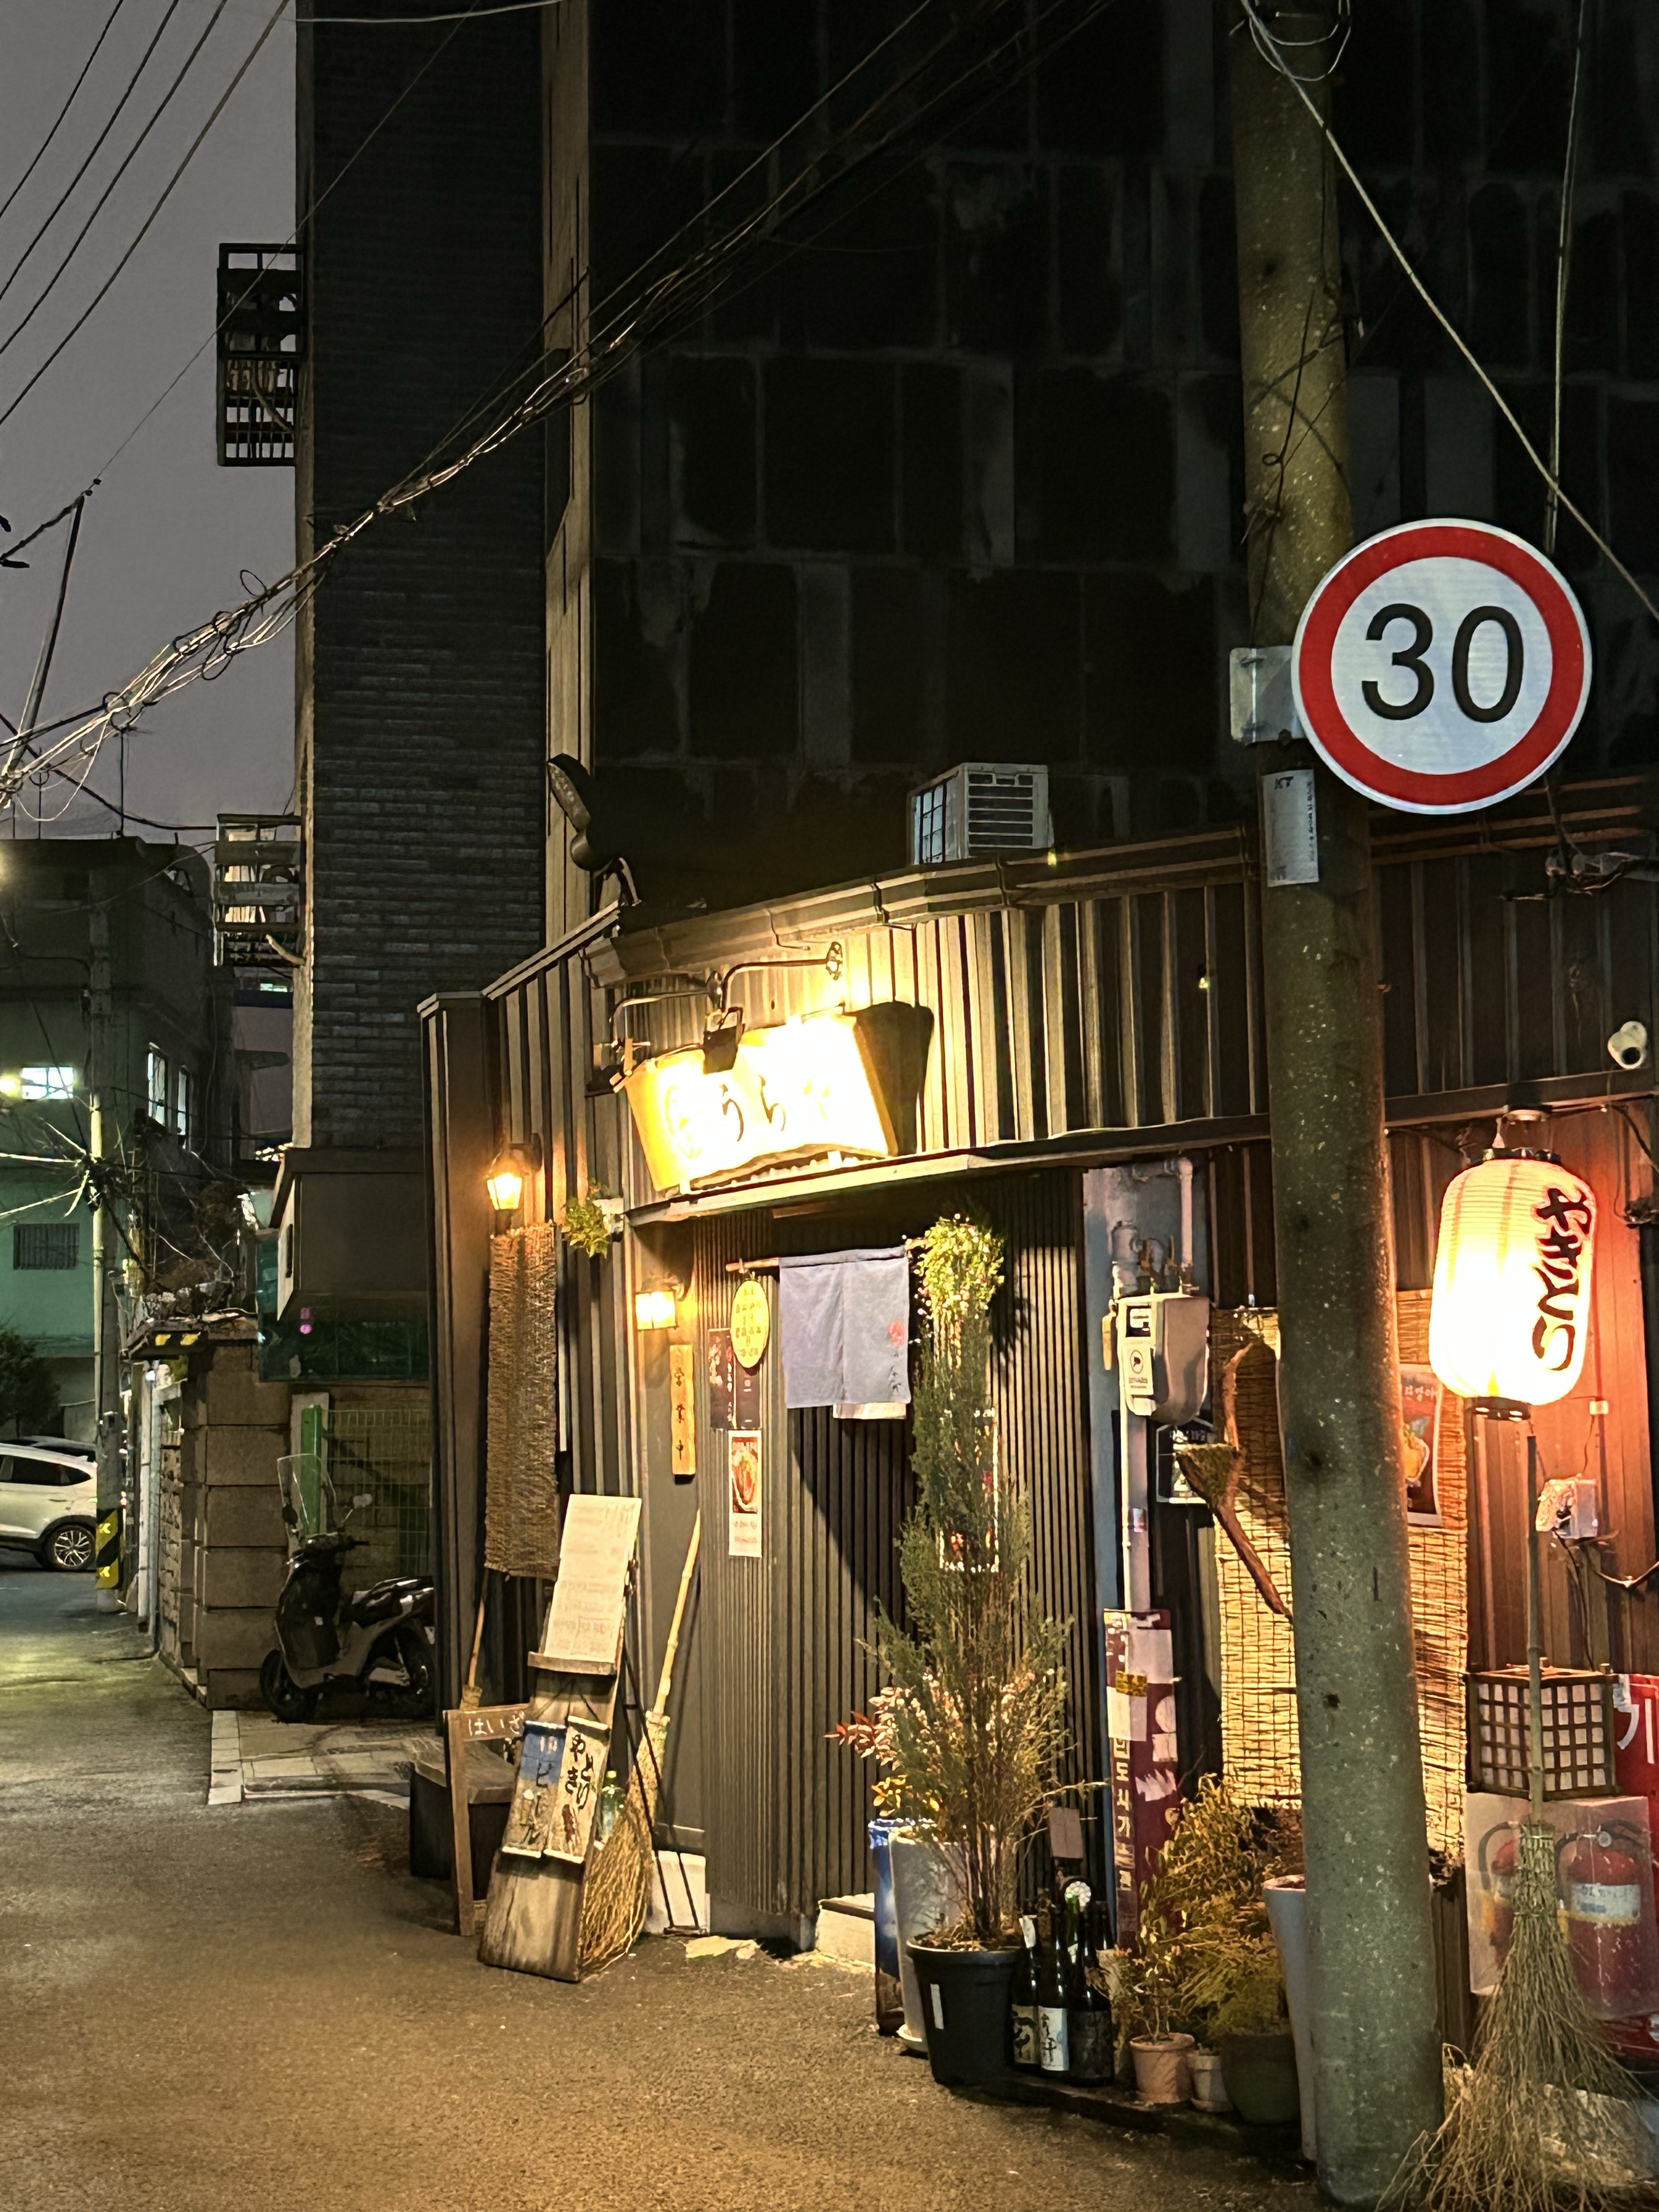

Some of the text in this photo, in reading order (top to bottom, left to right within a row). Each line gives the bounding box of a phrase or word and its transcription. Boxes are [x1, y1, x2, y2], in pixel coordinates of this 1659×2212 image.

[1361, 603, 1524, 724] 30
[1532, 1187, 1591, 1371] やきとり
